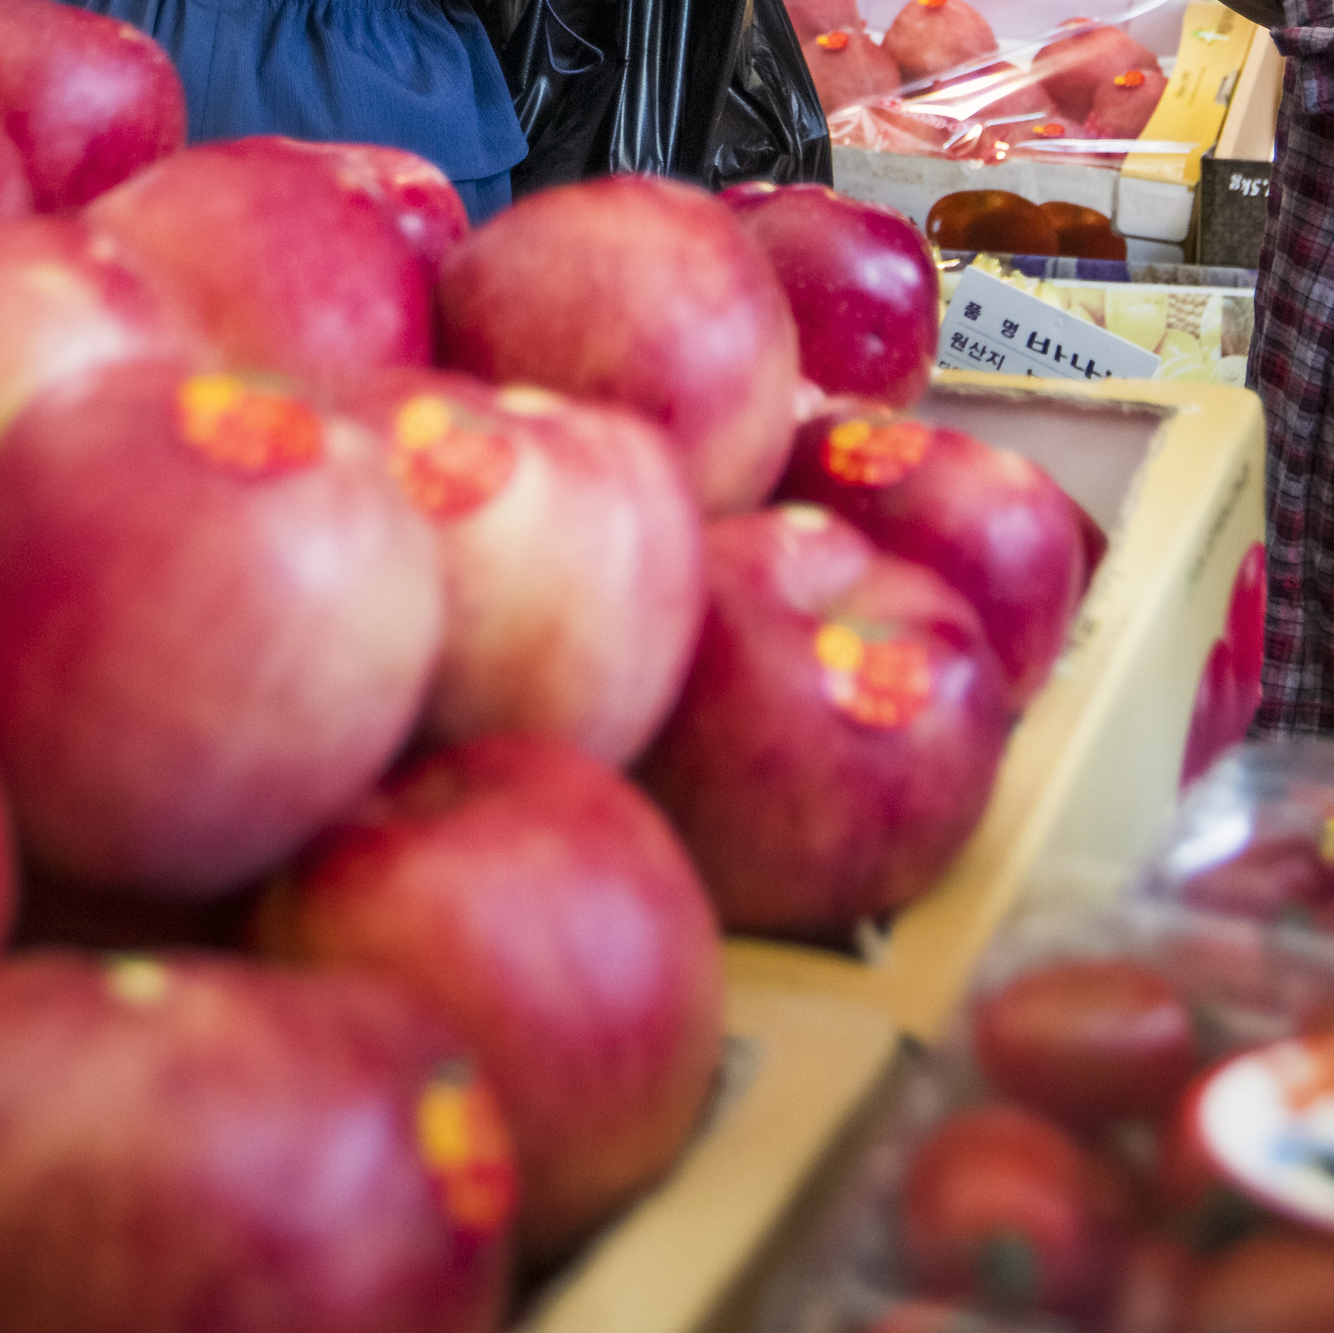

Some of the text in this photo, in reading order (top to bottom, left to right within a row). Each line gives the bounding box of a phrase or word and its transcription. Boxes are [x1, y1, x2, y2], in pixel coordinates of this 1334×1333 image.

[1229, 172, 1270, 197] .5kg
[950, 331, 1006, 371] 원산지
[964, 300, 1114, 380] 품 명 바나
